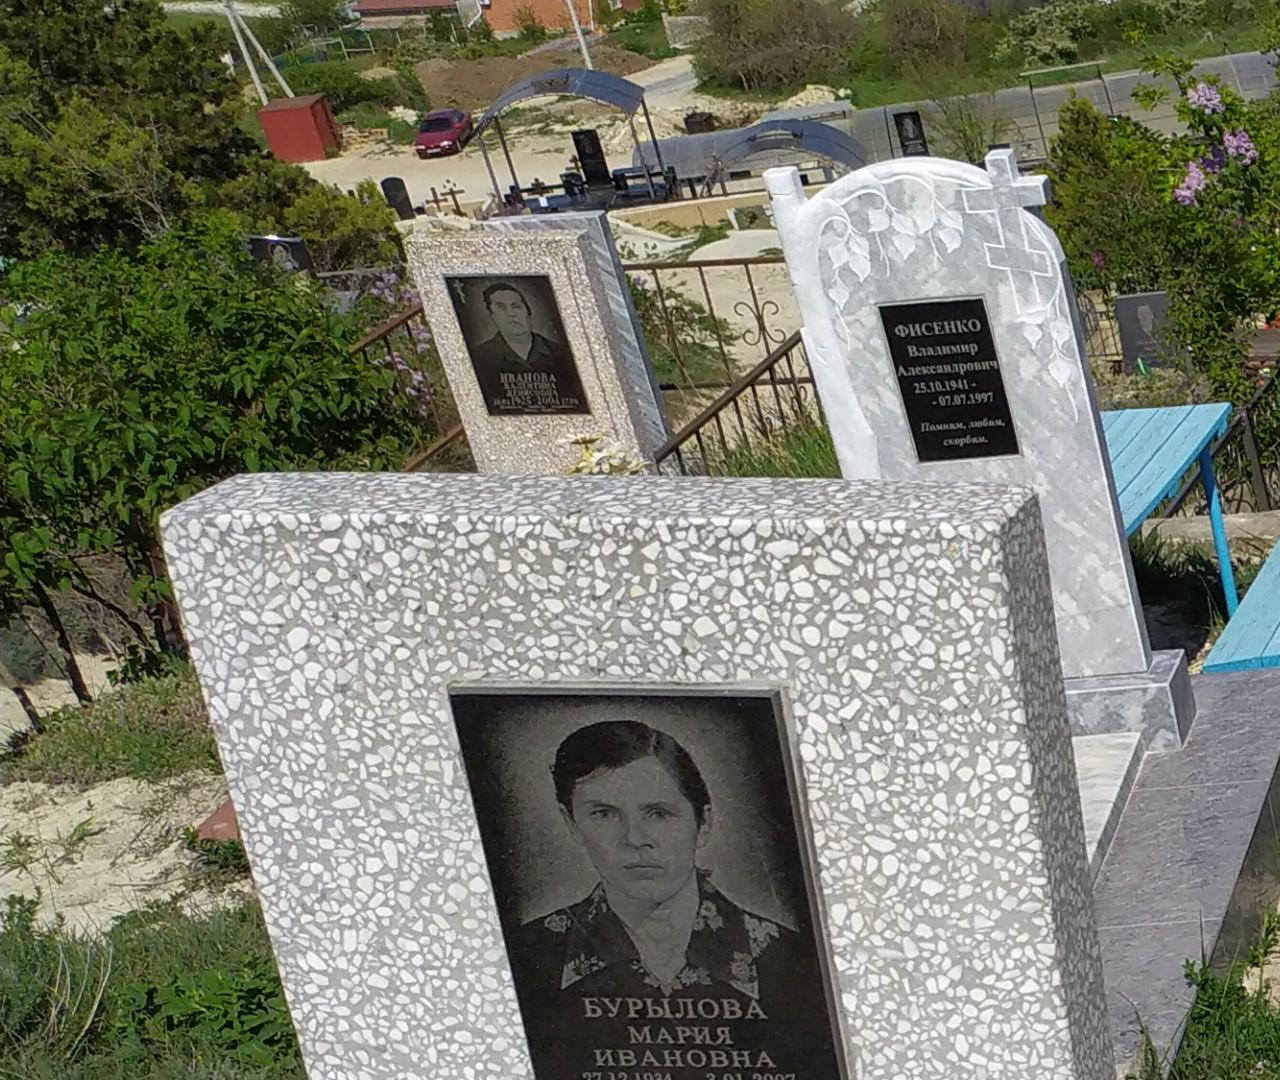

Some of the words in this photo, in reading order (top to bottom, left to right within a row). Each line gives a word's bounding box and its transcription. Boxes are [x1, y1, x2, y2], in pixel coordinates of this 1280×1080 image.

[894, 319, 982, 338] ФИСЕНКО
[906, 343, 978, 357] Владимир
[897, 360, 999, 377] Александрович
[500, 373, 557, 383] ИВАНОВА
[913, 379, 969, 394] 25.10.1941
[937, 392, 994, 407] 07.07.1997
[584, 998, 769, 1020] БУРЫЛОВА
[627, 1026, 735, 1045] МАРИЯ
[593, 1049, 778, 1069] ИВАНОВНА
